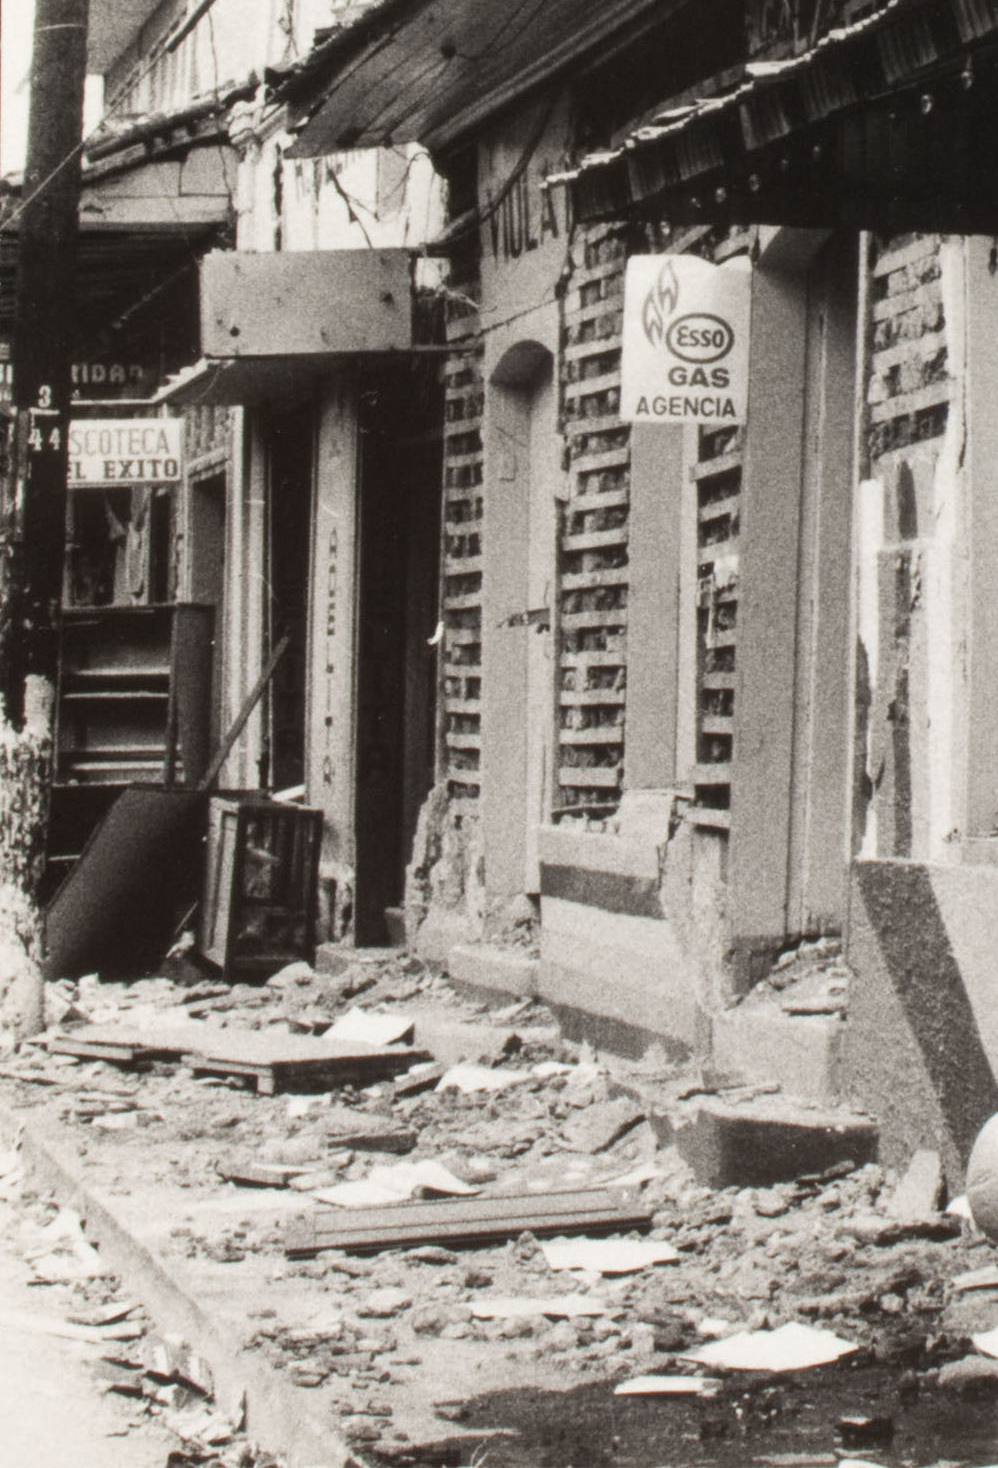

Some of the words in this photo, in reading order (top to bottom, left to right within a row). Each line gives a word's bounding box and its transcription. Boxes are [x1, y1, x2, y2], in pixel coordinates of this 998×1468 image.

[668, 366, 730, 389] GAS
[38, 385, 51, 407] 3
[636, 396, 736, 418] AGENCIA
[103, 458, 178, 479] EXITO
